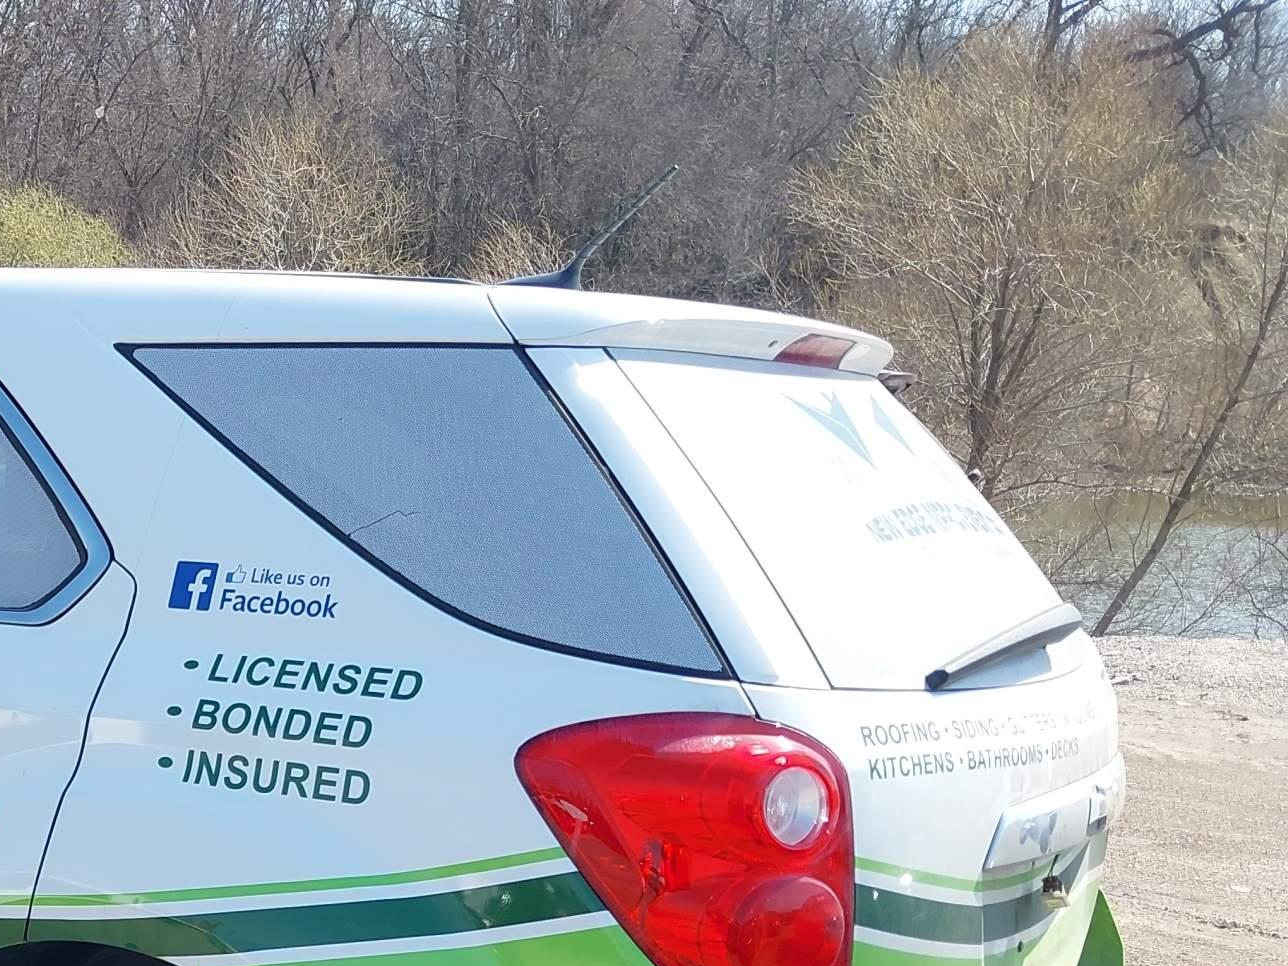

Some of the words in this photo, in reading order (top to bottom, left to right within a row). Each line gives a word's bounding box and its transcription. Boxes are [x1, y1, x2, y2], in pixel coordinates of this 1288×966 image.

[250, 568, 283, 585] Like
[287, 574, 305, 586] us
[310, 575, 330, 588] on
[219, 589, 338, 618] Facebook
[207, 653, 423, 700] LICENSED
[191, 699, 373, 748] BONDED
[860, 721, 940, 747] ROOFING
[951, 717, 999, 739] SIDING
[182, 749, 370, 805] INSURED
[868, 751, 954, 780] KITCHENS
[968, 744, 1043, 770] BATHROOMS
[1051, 737, 1079, 761] DECKS
